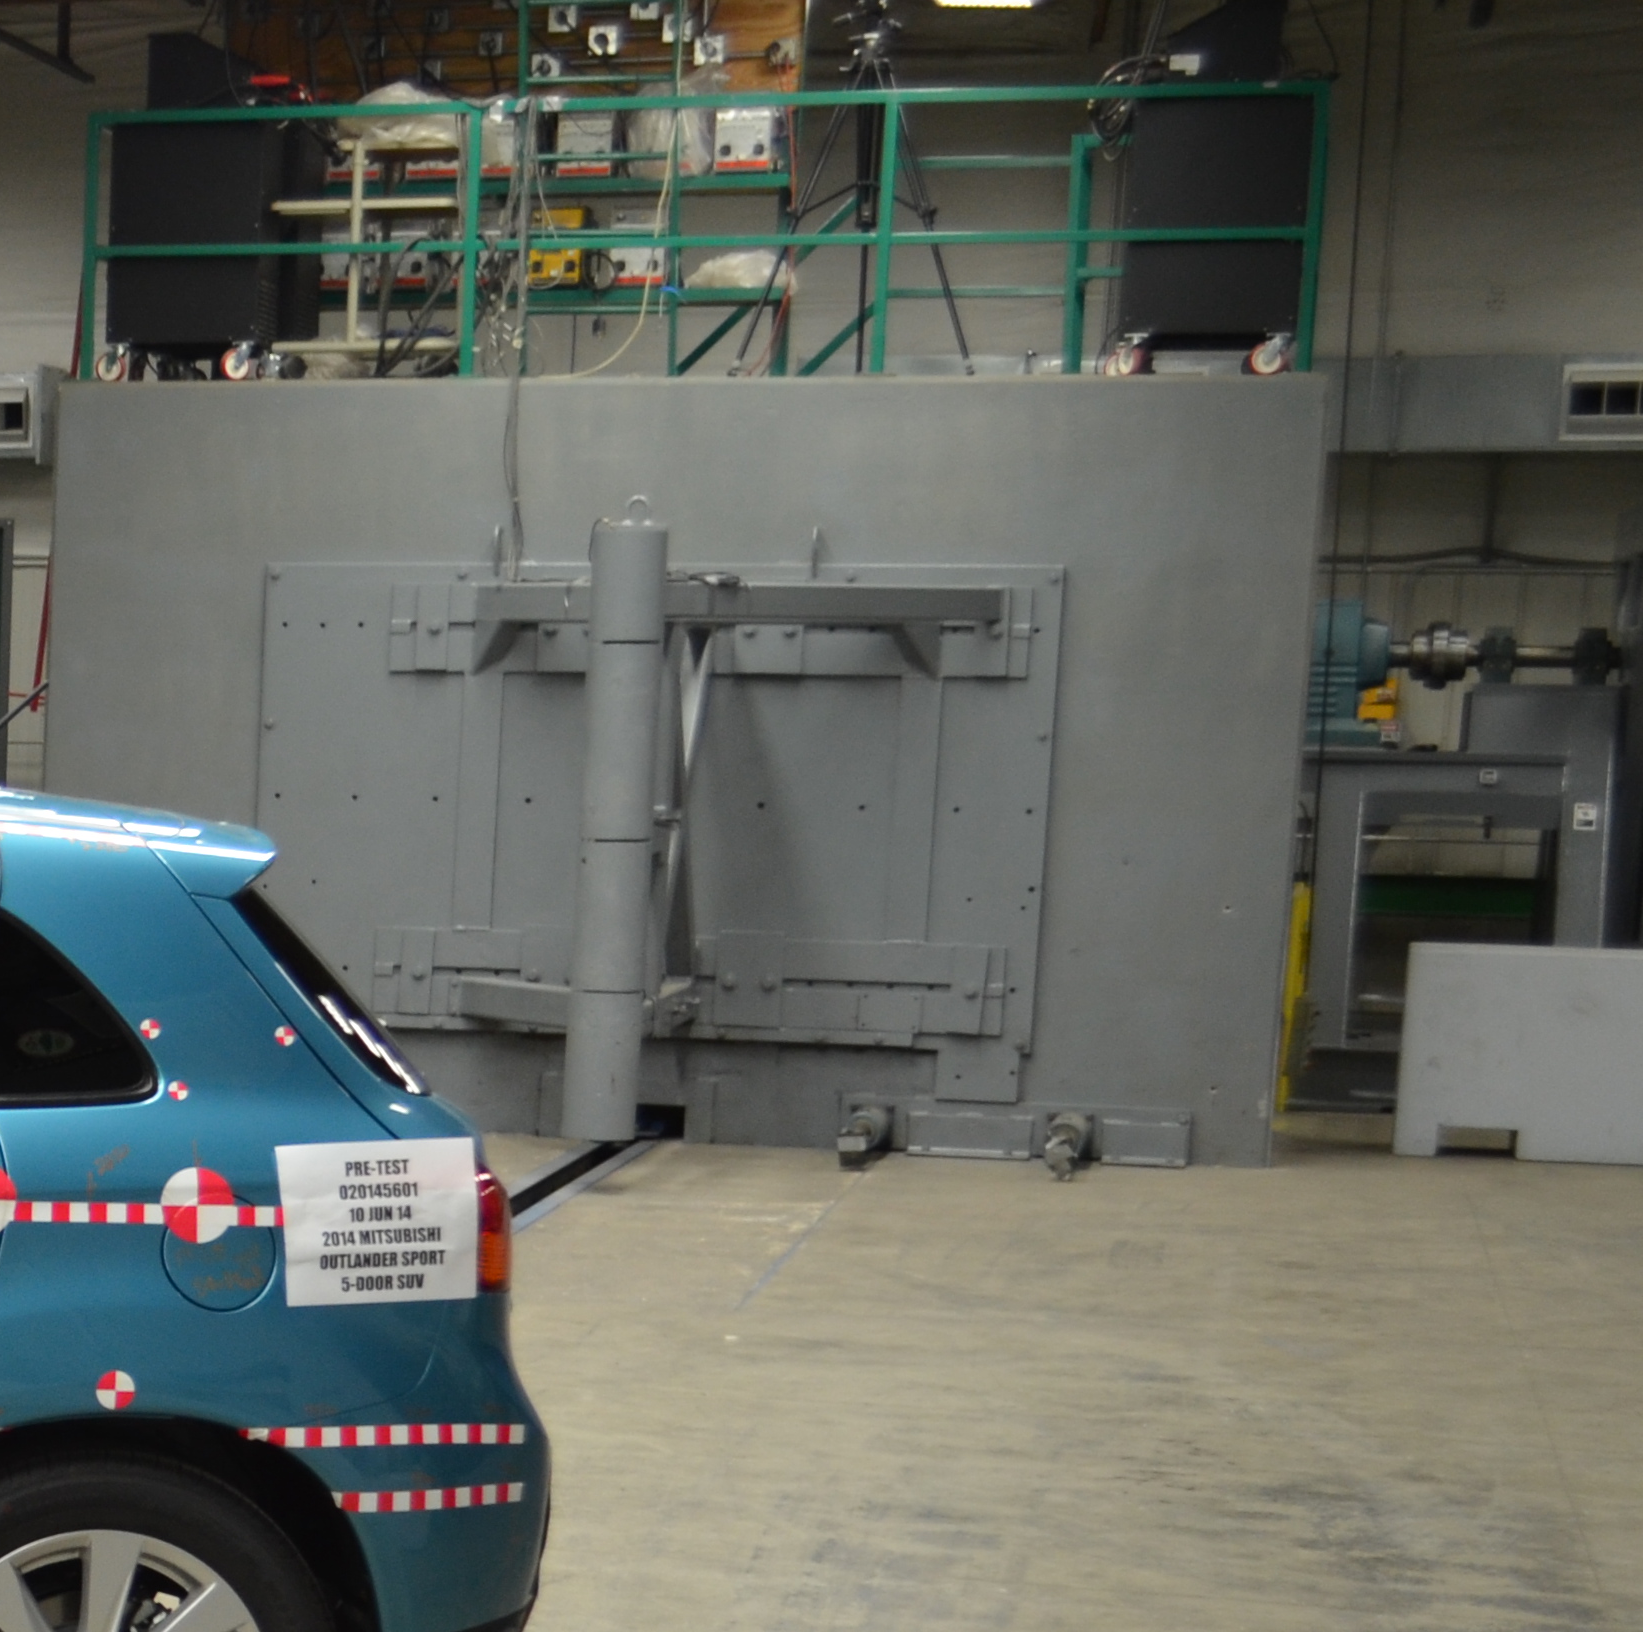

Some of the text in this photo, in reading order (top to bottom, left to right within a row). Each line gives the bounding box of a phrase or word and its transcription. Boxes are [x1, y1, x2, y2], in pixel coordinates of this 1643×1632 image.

[345, 1159, 409, 1177] PRE-TEST
[339, 1182, 418, 1200] 020145601
[350, 1205, 412, 1223] 10 JUN 14
[322, 1227, 442, 1247] 2014 MITSUBISHI
[320, 1250, 446, 1270] OUTLANDER SPORT
[341, 1274, 425, 1292] 5-DOOR SUV
